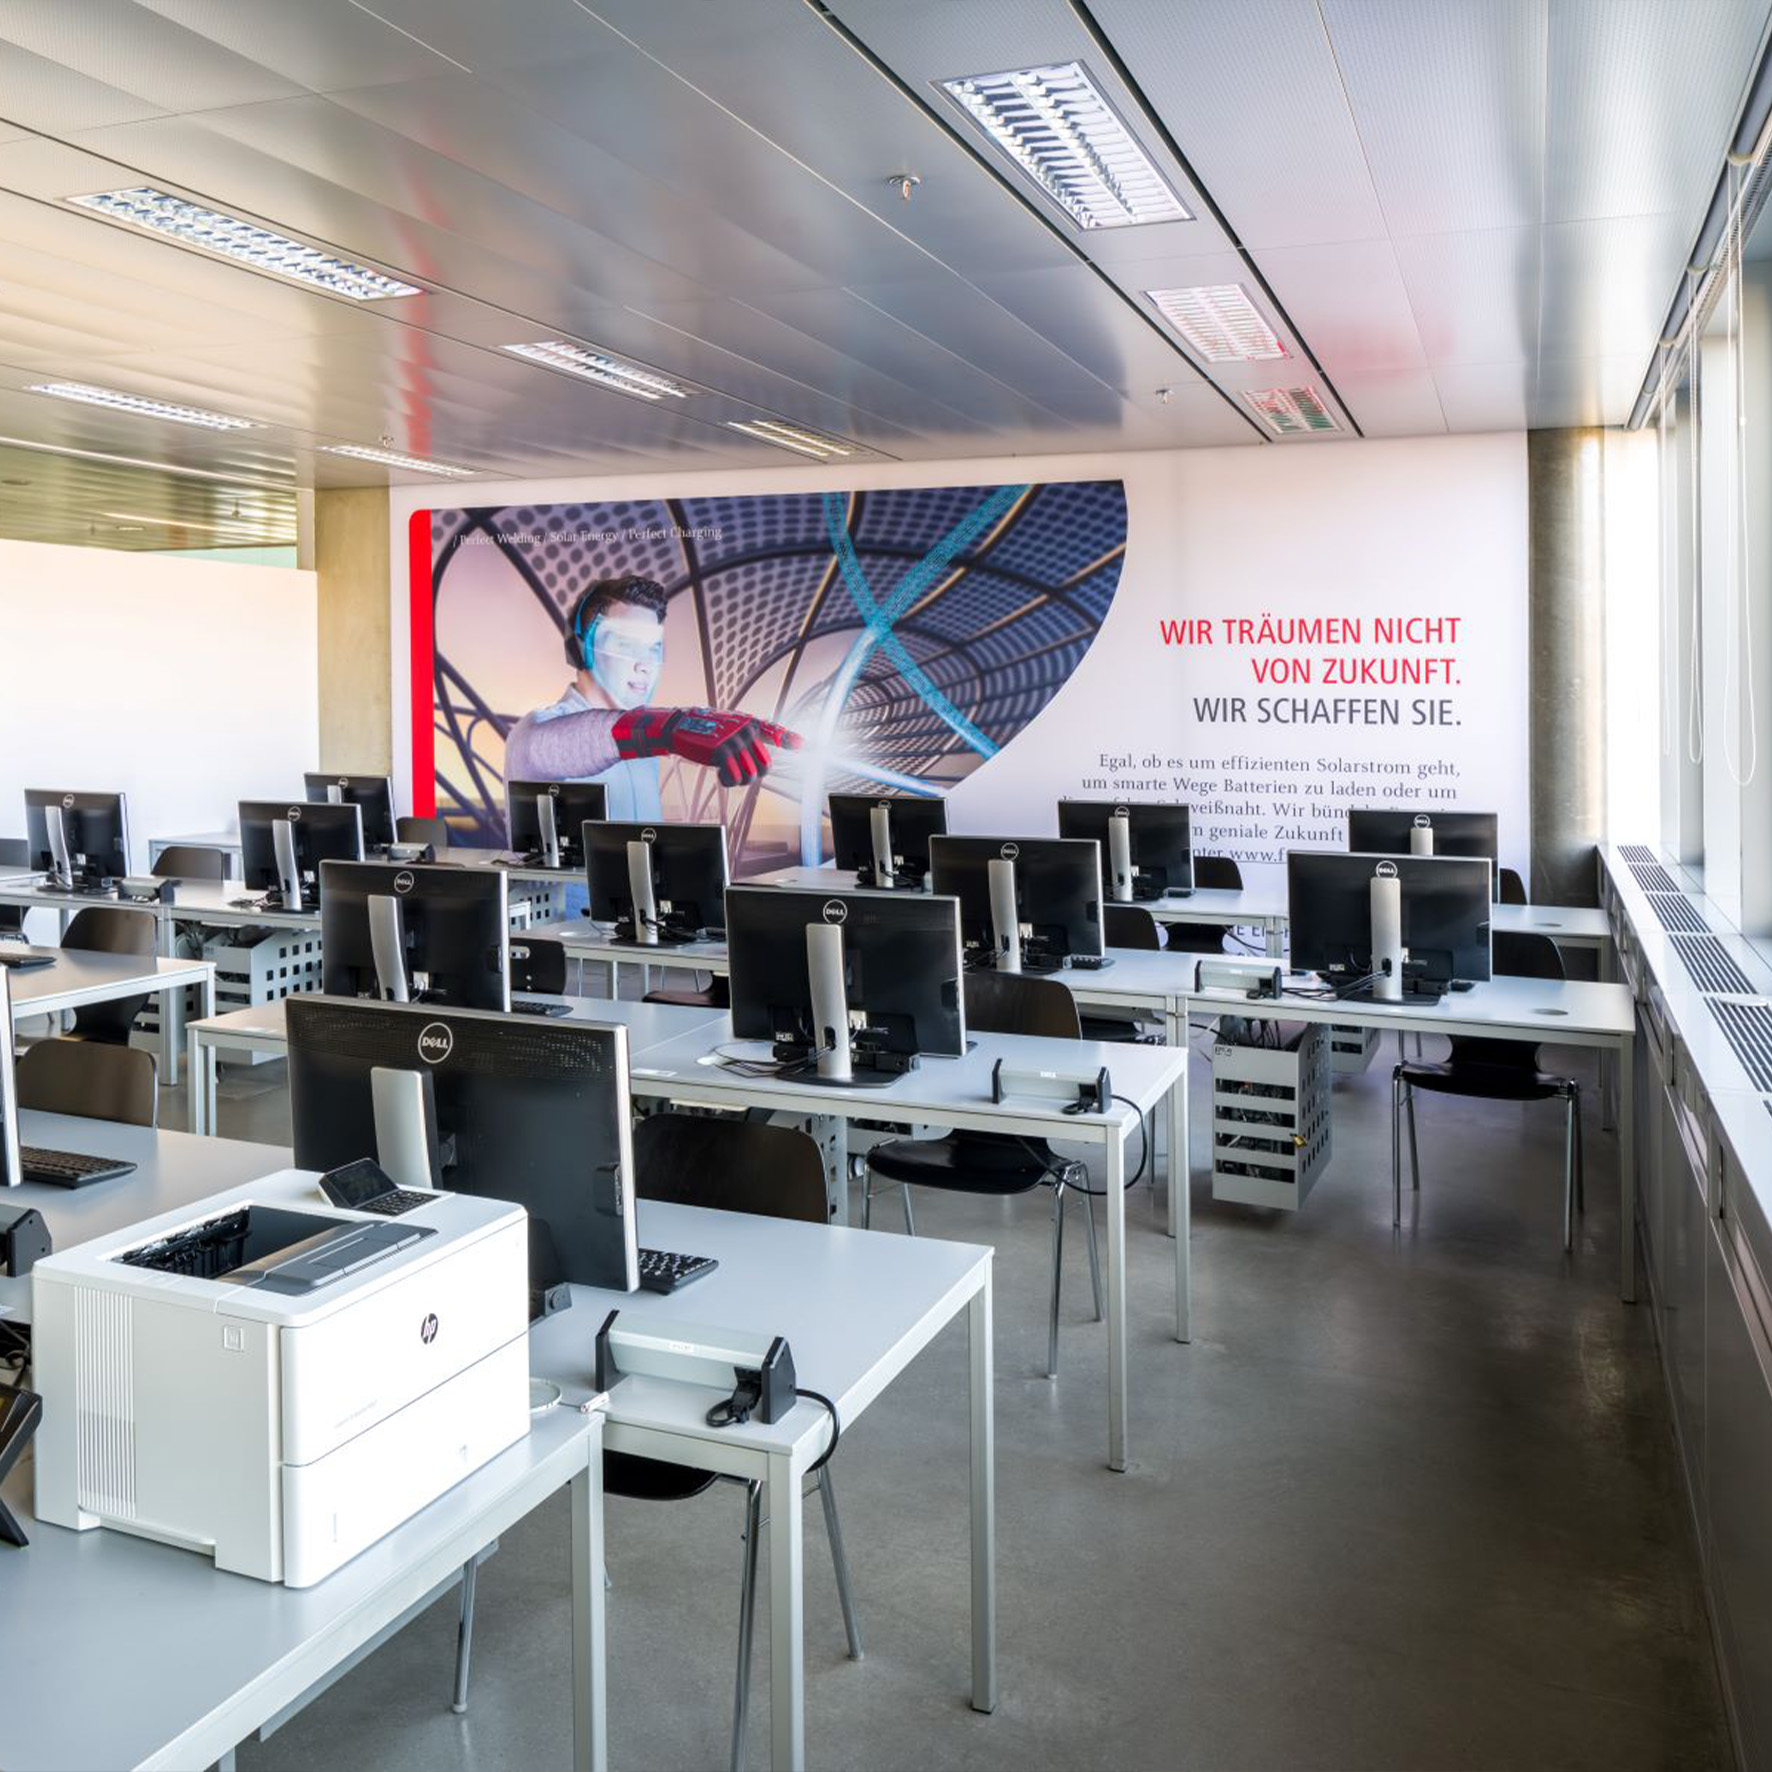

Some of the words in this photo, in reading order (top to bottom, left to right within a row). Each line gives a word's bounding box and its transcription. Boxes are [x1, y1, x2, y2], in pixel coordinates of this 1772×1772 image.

[460, 534, 494, 546] Perfect
[497, 532, 542, 546] Welding
[550, 531, 577, 543] Solar
[580, 529, 619, 544] Energy
[629, 526, 667, 540] Perfect
[670, 526, 722, 540] Charging
[1160, 619, 1213, 645] WIR
[1222, 613, 1361, 645] TRÄUMEN
[1374, 617, 1461, 644] NICHT
[1251, 658, 1311, 684] VON
[1322, 658, 1461, 685] ZUKUNFT.
[1193, 698, 1246, 723] WIR
[1257, 698, 1399, 725] SCHAFFEN
[1412, 699, 1462, 726] SIE.
[1099, 753, 1136, 772] Egal,
[1142, 753, 1162, 769] ob
[1167, 758, 1183, 769] es
[1189, 758, 1216, 770] um
[1221, 755, 1310, 773] effizienten
[1317, 757, 1411, 775] Solarstrom
[1417, 760, 1461, 779] geht,
[1082, 778, 1108, 790] um
[1112, 778, 1168, 791] smarte
[1173, 777, 1217, 796] Wege
[1223, 778, 1298, 795] Batterien
[1304, 784, 1324, 796] zu
[1331, 780, 1377, 797] laden
[1382, 782, 1422, 799] oder
[1428, 787, 1457, 800] um
[1272, 802, 1306, 817] Wir
[1209, 824, 1268, 842] geniale
[1274, 825, 1344, 842] Zukunft
[421, 1313, 438, 1345] hp
